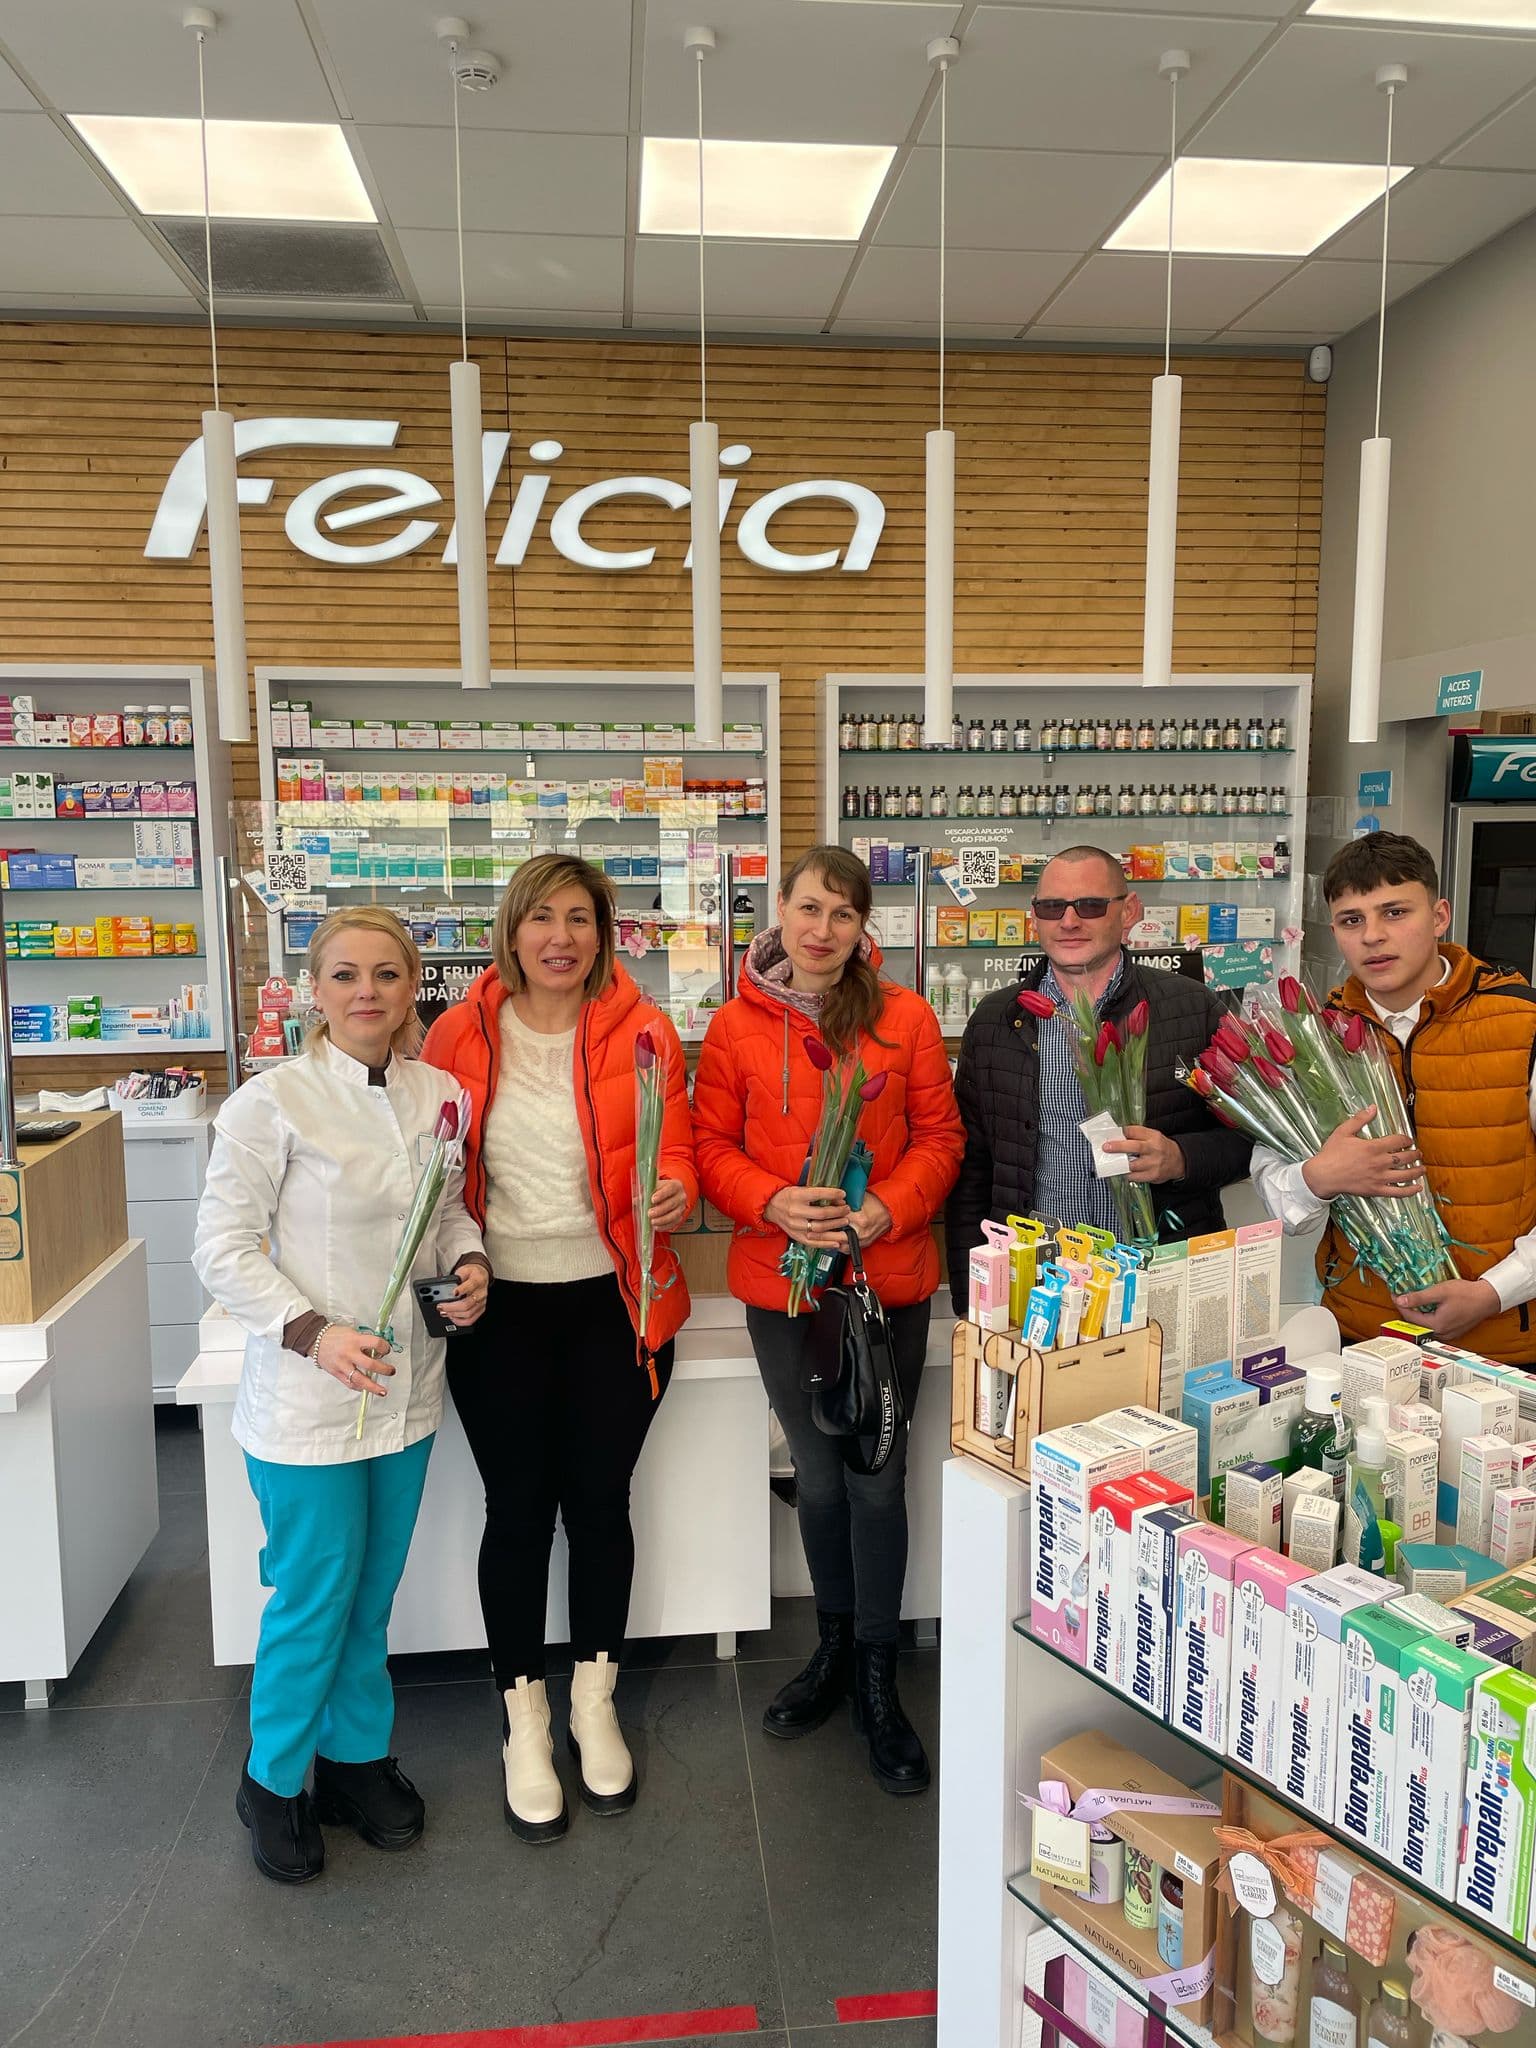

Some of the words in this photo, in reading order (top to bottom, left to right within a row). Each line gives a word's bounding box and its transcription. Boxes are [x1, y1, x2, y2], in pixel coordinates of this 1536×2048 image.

[1447, 679, 1471, 693] ACCES
[1442, 694, 1473, 708] INTERZIS
[950, 835, 973, 843] CARD
[974, 835, 1008, 843] FRUMOS
[1139, 923, 1161, 932] -25%
[984, 958, 1041, 972] PREZIN
[1132, 955, 1181, 970] UMOS
[1237, 965, 1257, 973] FRUMOS
[102, 1022, 136, 1031] Bepanthen
[1031, 1302, 1045, 1315] Kids
[1389, 1362, 1414, 1379] nore
[882, 1386, 893, 1425] POLINA
[1120, 1408, 1179, 1431] Biorepair
[1217, 1457, 1234, 1469] Face
[1235, 1451, 1254, 1465] Mask
[1409, 1451, 1437, 1466] noreva
[1412, 1510, 1431, 1531] BB
[1036, 1484, 1057, 1600] Biorepair
[1301, 1583, 1342, 1607] Biorepair
[1093, 1590, 1112, 1675] Biorepair
[1473, 1630, 1510, 1650] HINACEA
[1132, 1592, 1156, 1703] Biorepair
[1157, 1655, 1163, 1663] of
[1182, 1620, 1209, 1734] Biorepair
[1198, 1615, 1207, 1632] Plus
[1417, 1677, 1425, 1686] lei
[1415, 1685, 1423, 1698] 109
[1237, 1670, 1260, 1764] Biorepair
[1250, 1663, 1258, 1682] Plus
[1287, 1703, 1311, 1799] Biorepair
[1300, 1696, 1309, 1714] Plus
[1487, 1737, 1495, 1760] ANNI
[1344, 1713, 1375, 1838] Biorepair
[1364, 1708, 1373, 1727] Plus
[1484, 1761, 1494, 1779] 6-12
[1495, 1739, 1514, 1798] JUNIOR
[1092, 1794, 1106, 1806] OIL
[1108, 1795, 1152, 1806] NATURAL
[1374, 1769, 1383, 1820] PROTECTION
[1403, 1773, 1430, 1876] Biorepair
[1419, 1766, 1428, 1786] Plus
[1373, 1821, 1381, 1844] TOTAL
[1466, 1780, 1505, 1913] Biorepair
[1036, 1865, 1071, 1883] NATURAL
[1072, 1877, 1086, 1887] OIL
[1239, 1883, 1268, 1896] SCENTED
[1242, 1890, 1268, 1901] GARDEN
[1084, 1923, 1127, 1964] NATURAL
[1128, 1959, 1145, 1977] OIL
[1314, 2021, 1348, 2040] SCENTED
[1314, 2028, 1346, 2047] GARDEN
